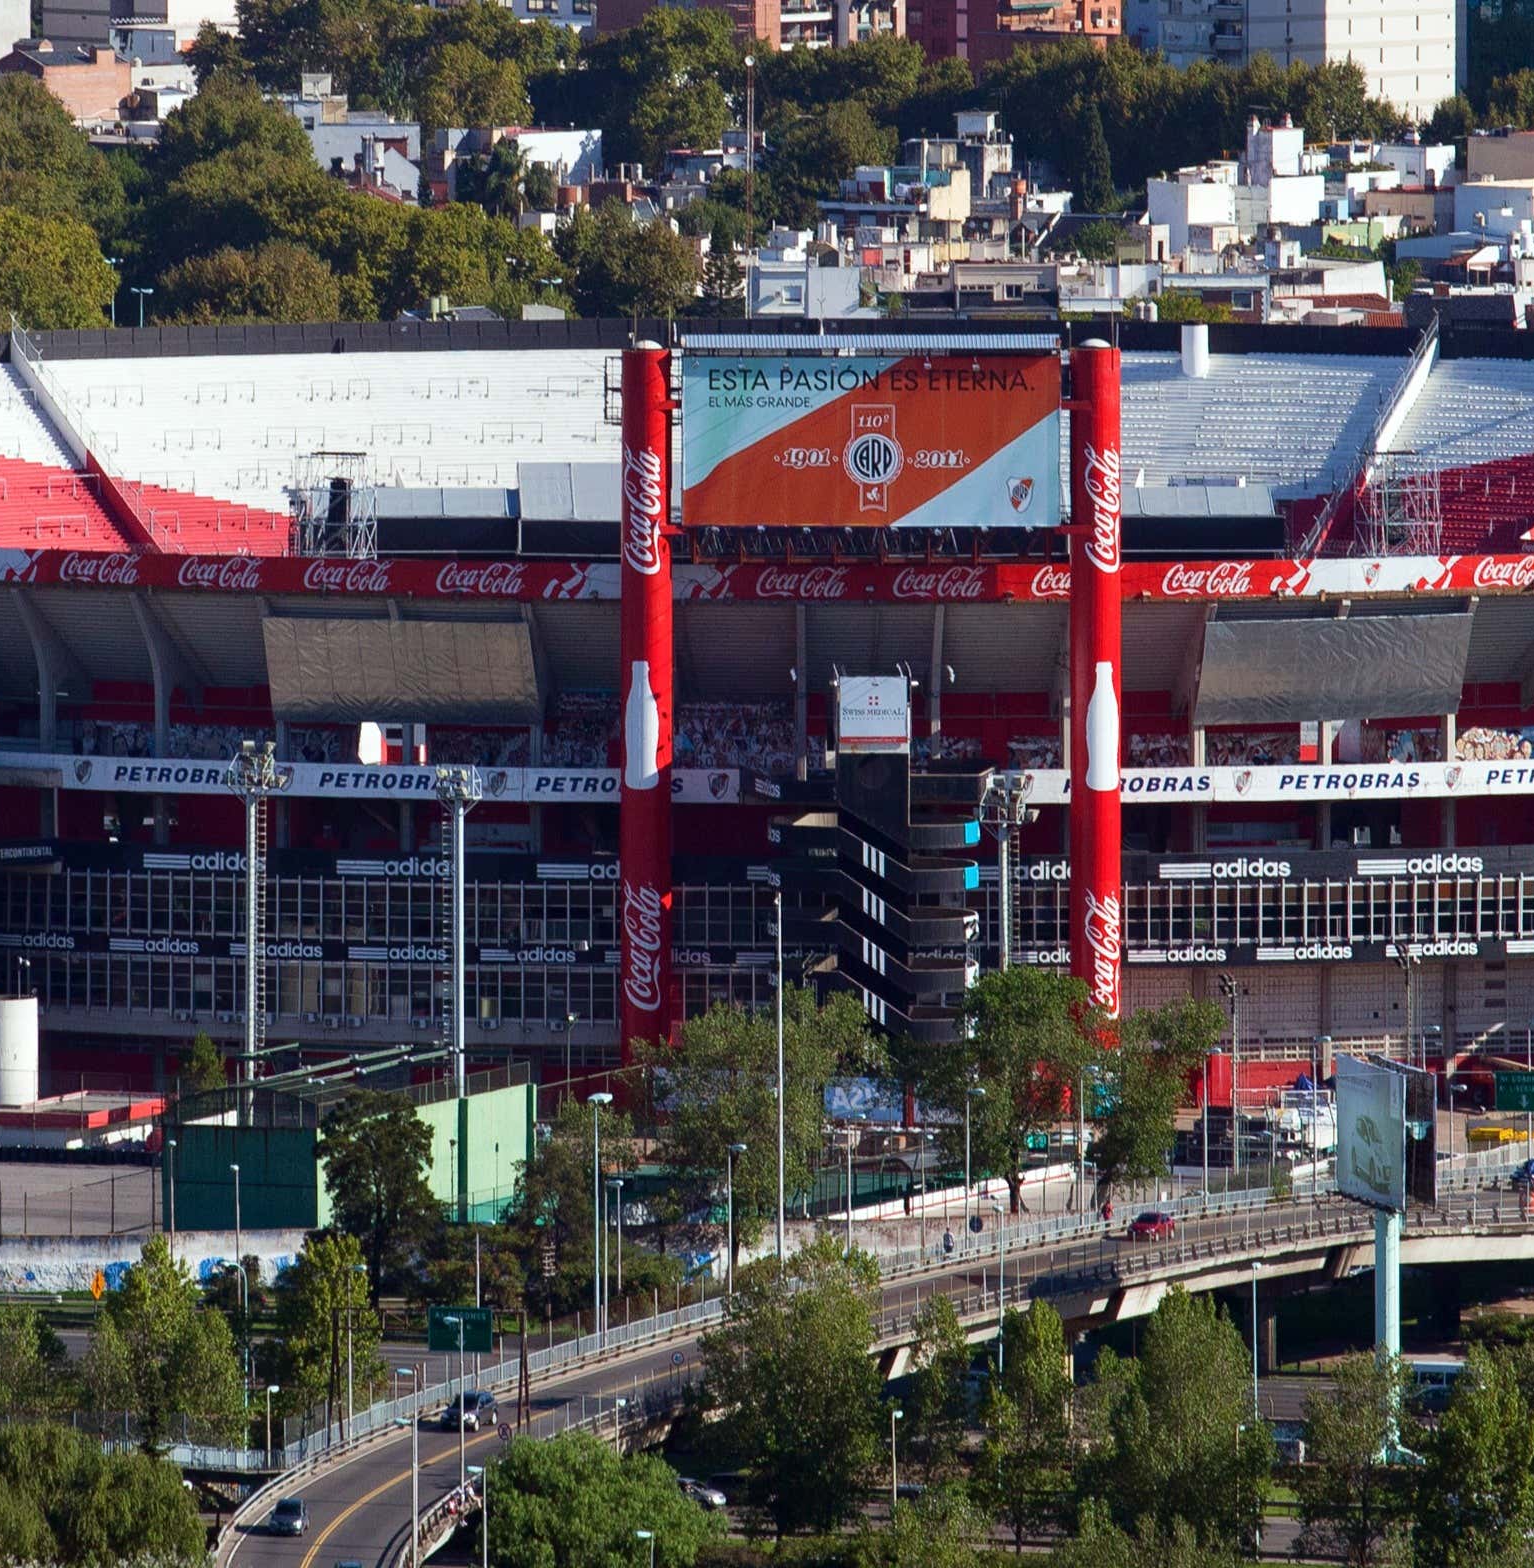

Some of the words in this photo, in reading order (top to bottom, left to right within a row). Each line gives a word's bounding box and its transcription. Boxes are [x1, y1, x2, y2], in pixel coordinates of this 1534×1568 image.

[708, 368, 767, 392] ESTA
[780, 365, 880, 392] PASIÓN
[889, 368, 919, 392] ES
[928, 368, 1035, 392] ETERNA.
[708, 396, 721, 408] EL
[724, 394, 754, 408] MÁS
[756, 396, 813, 408] GRANDE.
[624, 442, 661, 575] Coca-Cola
[1084, 441, 1120, 573] Coca-Cola
[60, 551, 142, 584] Coca-Cola
[178, 556, 265, 588] Coca-Cola
[303, 560, 394, 591] Coca-Cola
[435, 561, 528, 594] Coca-Cola
[1162, 562, 1255, 595] Coca-Cola
[756, 566, 847, 598] Coca-Cola
[893, 565, 986, 598] Coca-Cola
[1279, 771, 1421, 790] PETROBRAS
[1211, 857, 1291, 879] adidas
[1407, 853, 1484, 875] adidas
[22, 932, 74, 949] adidas
[145, 938, 199, 953] adidas
[266, 942, 323, 958] adidas
[624, 879, 661, 1011] Coca-Cola
[1295, 942, 1353, 960] adidas
[1423, 939, 1478, 957] adidas
[389, 944, 447, 962] adidas
[516, 946, 577, 963] adidas
[1167, 944, 1227, 962] adidas
